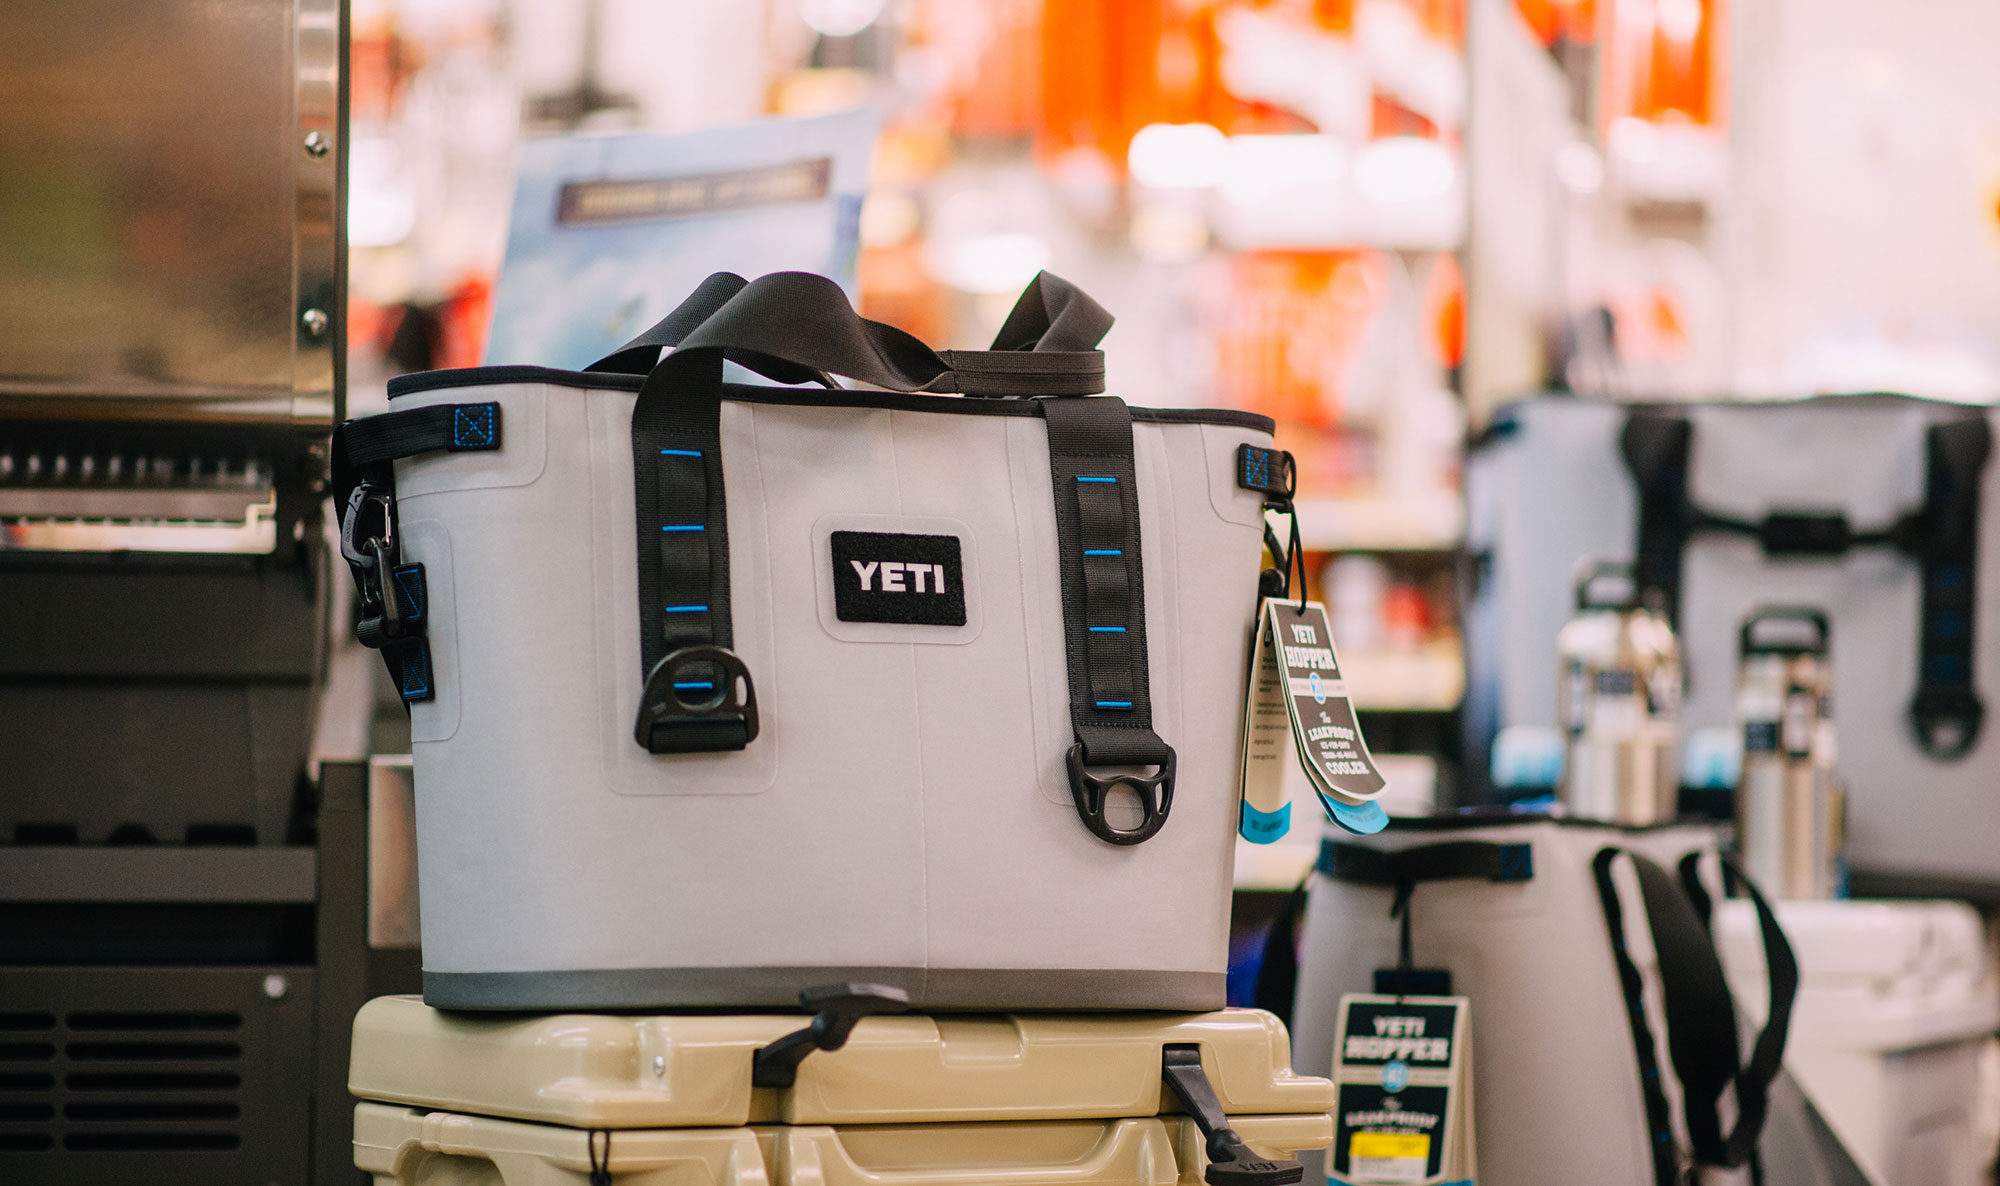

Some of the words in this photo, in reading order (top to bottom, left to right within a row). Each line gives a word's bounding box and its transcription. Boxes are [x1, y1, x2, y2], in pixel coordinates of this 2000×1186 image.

[850, 560, 946, 594] YETI
[1290, 624, 1317, 645] YETI
[1285, 646, 1336, 670] HOPPER
[1308, 726, 1354, 741] LEAKPROOF
[1326, 761, 1370, 775] COOLER
[1373, 1016, 1425, 1036] YETI
[1346, 1036, 1449, 1060] HOPPER
[1238, 1162, 1279, 1171] YETI
